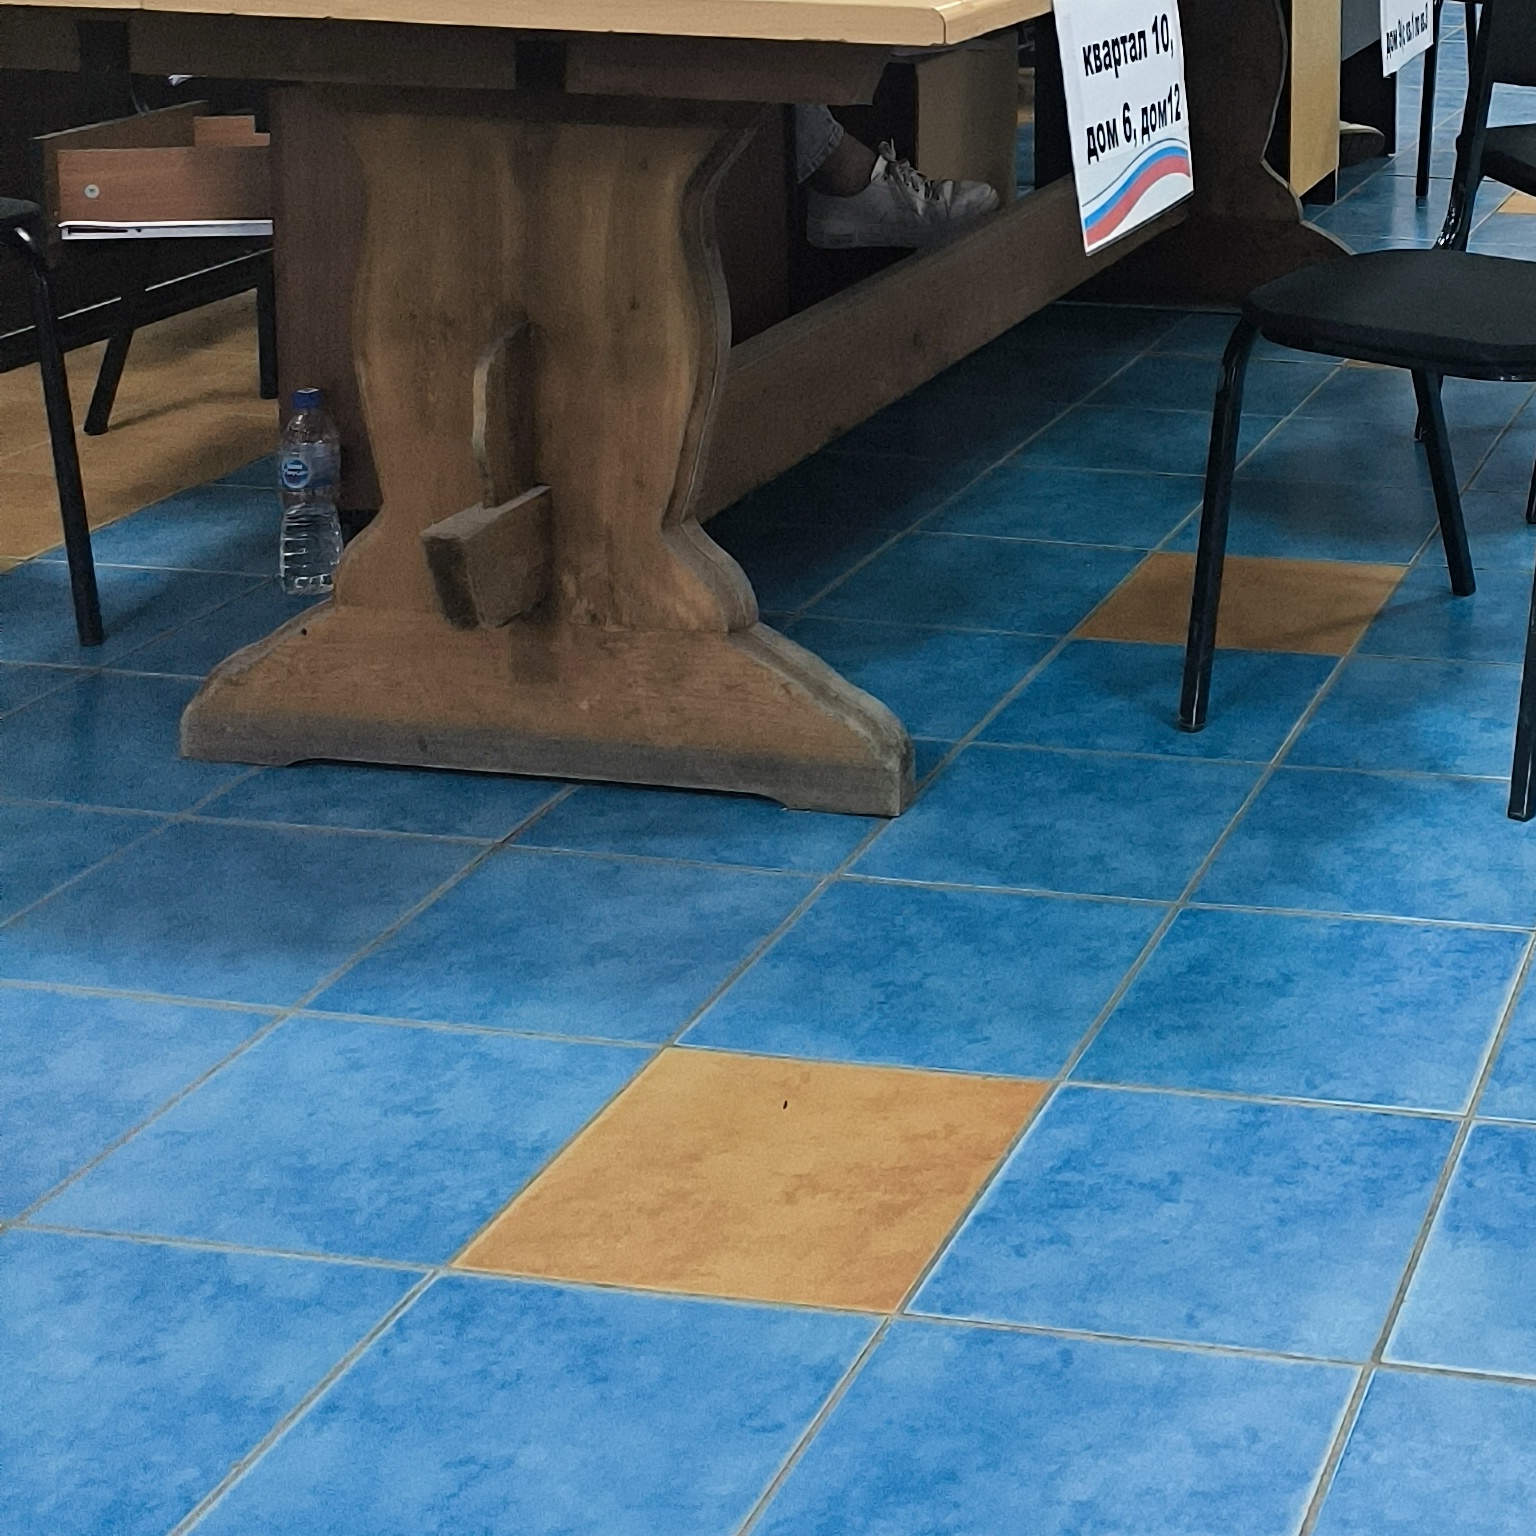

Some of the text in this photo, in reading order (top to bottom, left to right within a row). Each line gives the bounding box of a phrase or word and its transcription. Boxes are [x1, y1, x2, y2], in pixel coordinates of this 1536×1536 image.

[1082, 13, 1174, 79] квартал 10,
[1086, 83, 1181, 165] дом 6, дом12
